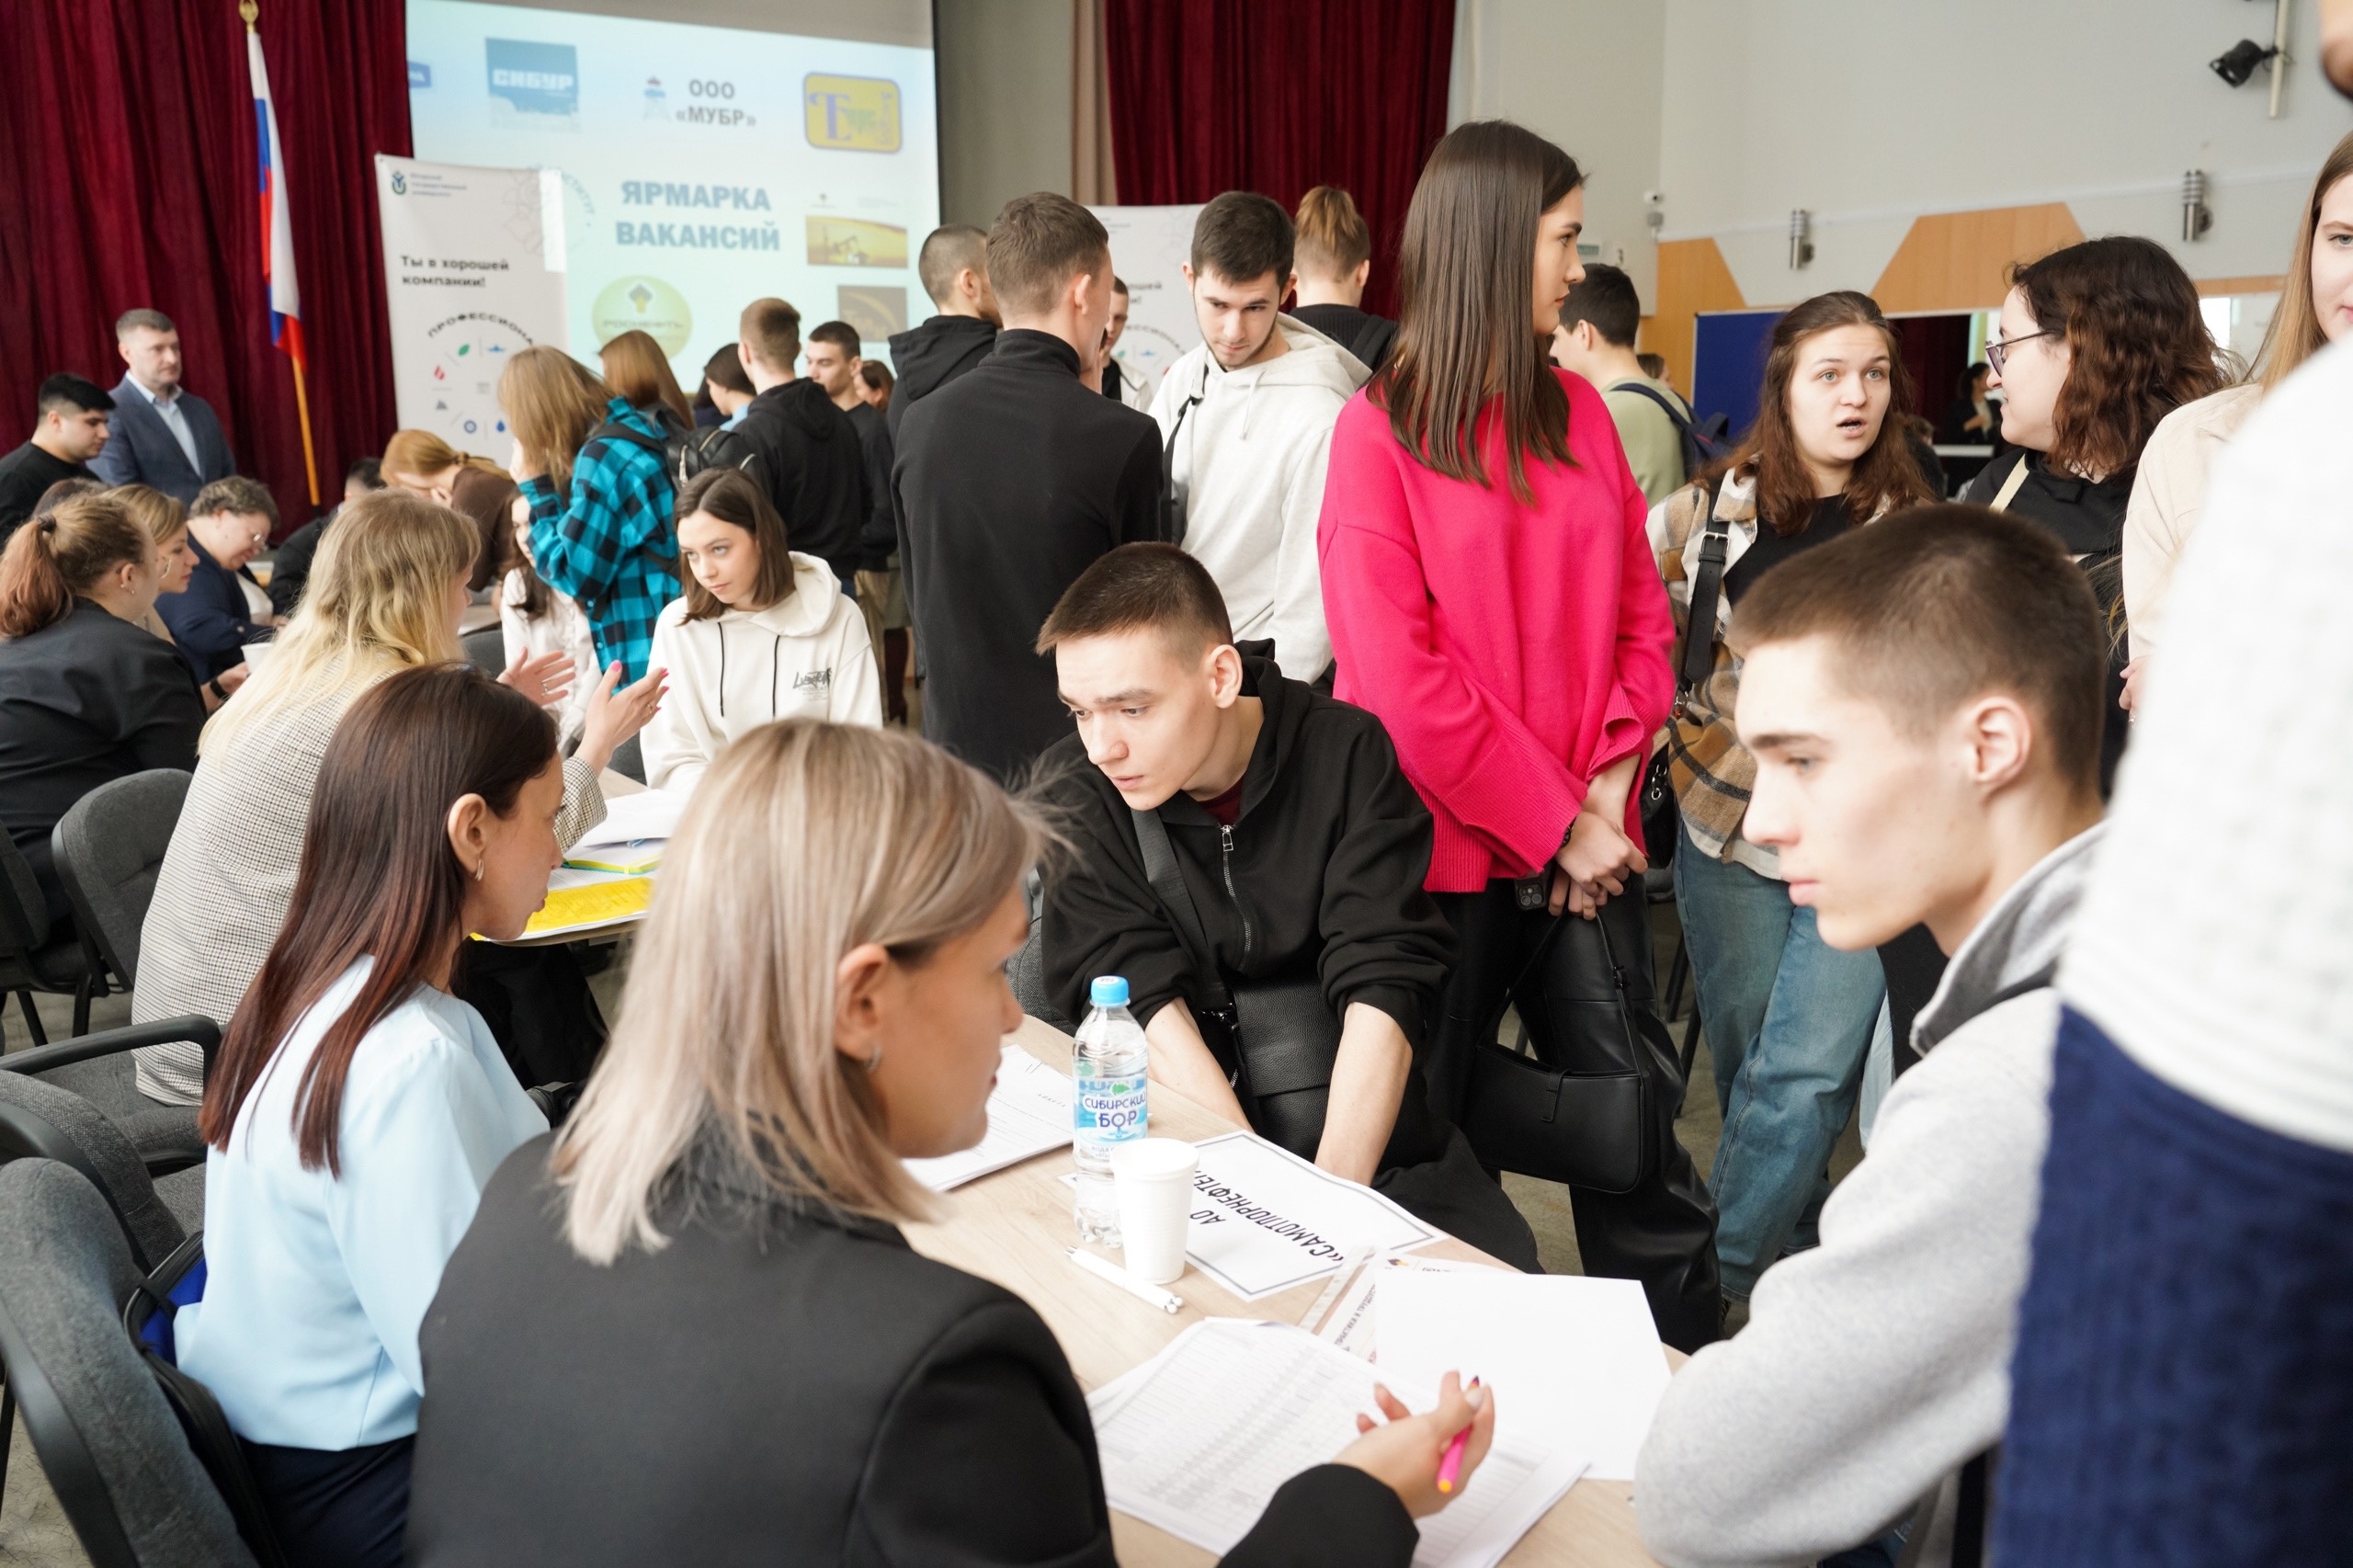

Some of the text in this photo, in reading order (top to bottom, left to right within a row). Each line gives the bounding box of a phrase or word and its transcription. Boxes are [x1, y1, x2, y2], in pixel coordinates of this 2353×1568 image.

[492, 68, 574, 91] СИБУР
[688, 79, 735, 99] ООО
[676, 106, 757, 127] «МУБР»
[621, 180, 772, 211] ЯРМАРКА
[615, 220, 780, 251] ВАКАНСИЙ
[401, 256, 509, 271] Ты в хорошей
[402, 276, 486, 288] компании!
[427, 312, 533, 346] ПРОФЕССИОНА
[1098, 1110, 1138, 1128] БОР
[1189, 1210, 1226, 1224] АО
